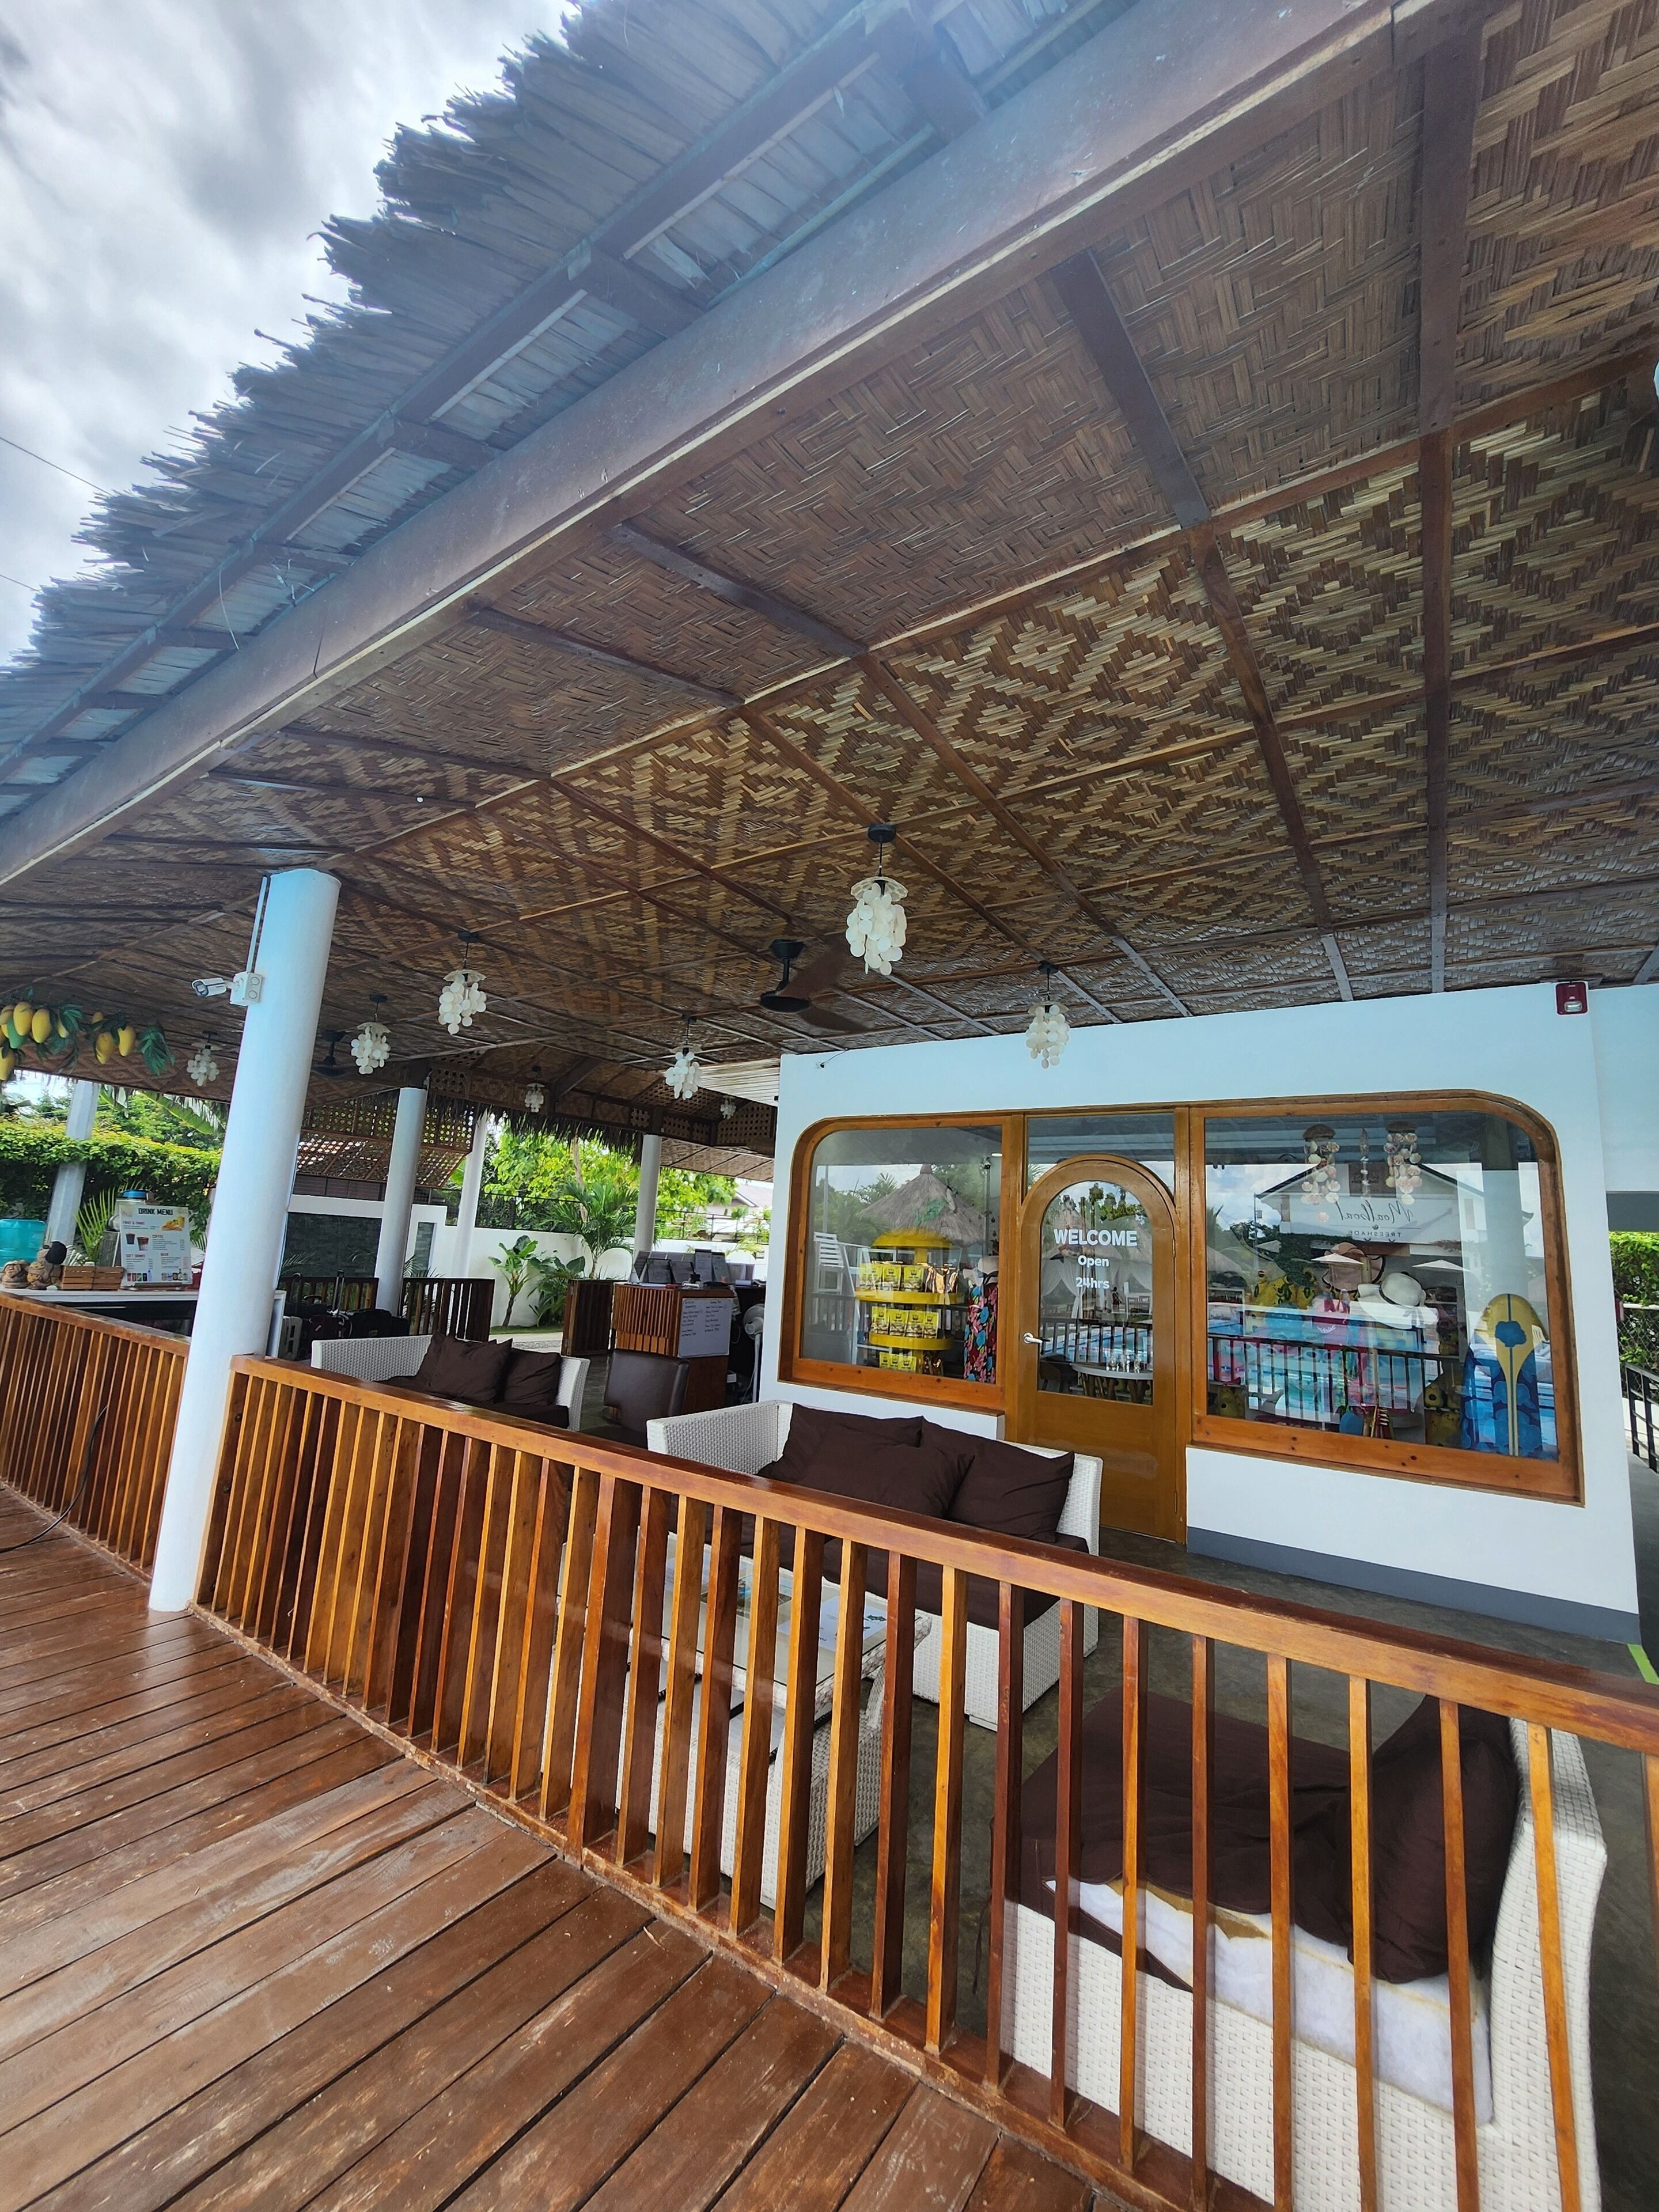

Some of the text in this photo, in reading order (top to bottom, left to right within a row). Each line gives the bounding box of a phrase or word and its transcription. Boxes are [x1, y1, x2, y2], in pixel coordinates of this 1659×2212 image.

[1054, 1228, 1138, 1247] WELCOME
[1078, 1255, 1109, 1267] Open
[1075, 1277, 1110, 1289] 24hrs
